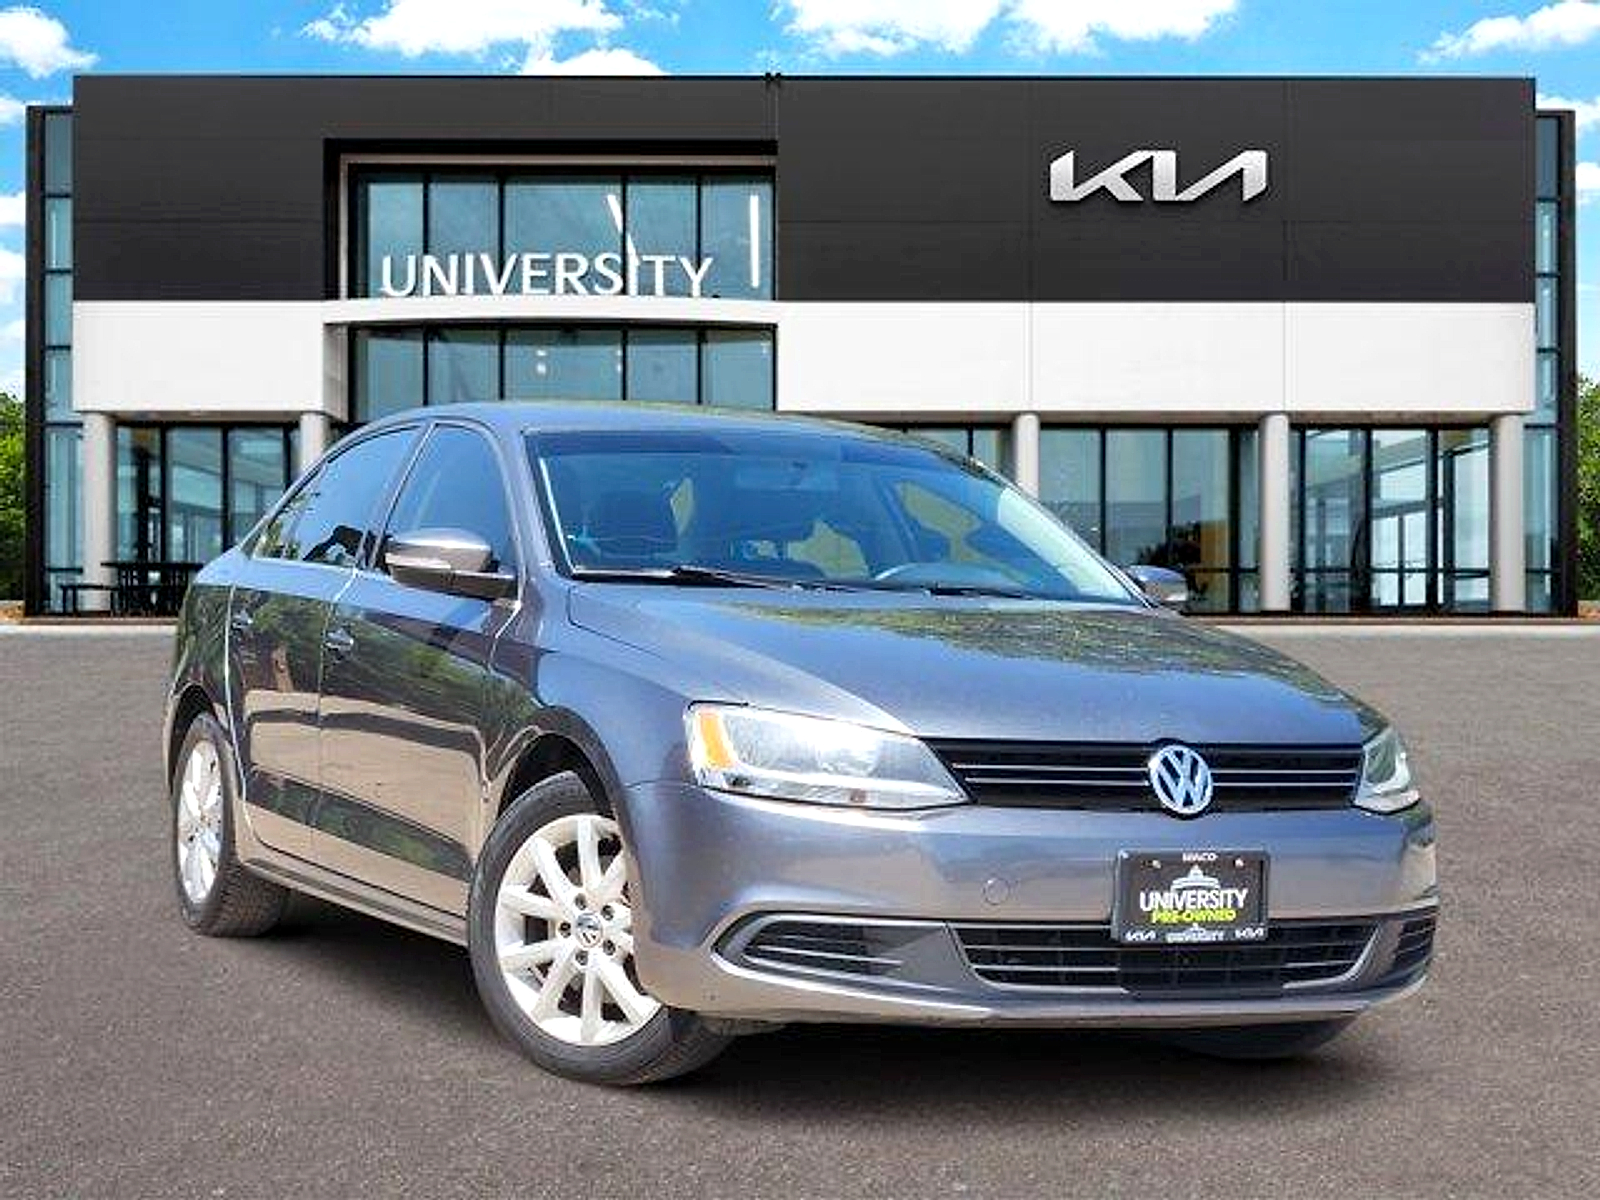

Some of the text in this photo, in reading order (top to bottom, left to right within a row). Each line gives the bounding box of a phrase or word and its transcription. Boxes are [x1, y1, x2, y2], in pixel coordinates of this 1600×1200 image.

[1050, 150, 1267, 202] KIA
[380, 252, 714, 298] UNIVERSITY
[1139, 887, 1248, 911] UNIVERSITY
